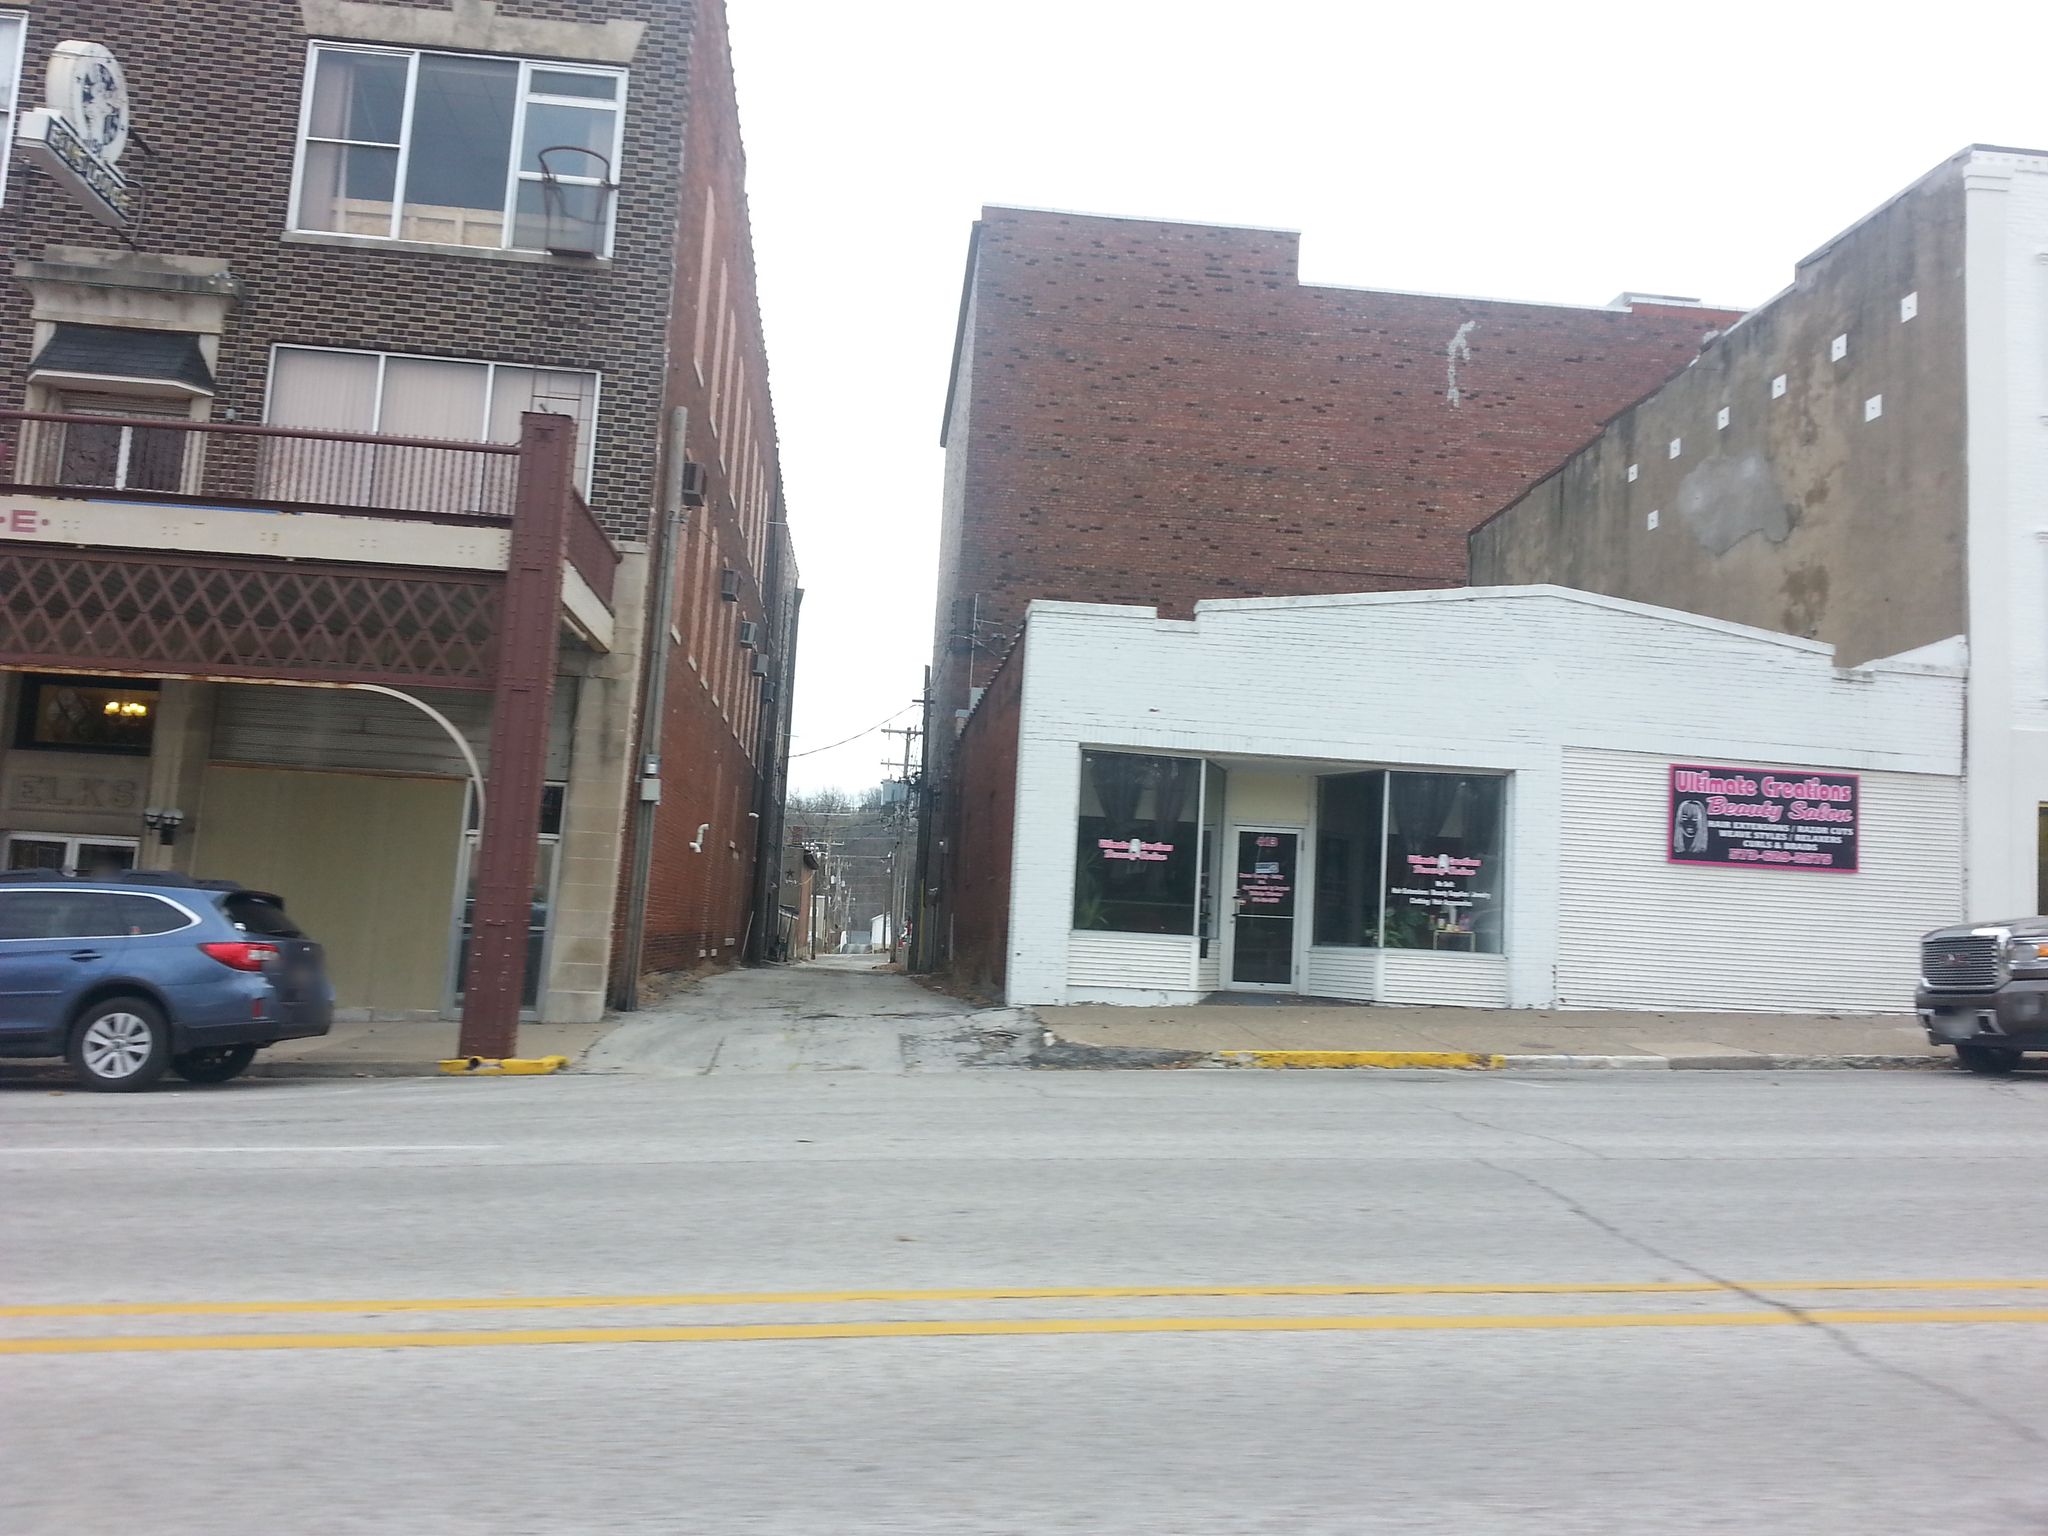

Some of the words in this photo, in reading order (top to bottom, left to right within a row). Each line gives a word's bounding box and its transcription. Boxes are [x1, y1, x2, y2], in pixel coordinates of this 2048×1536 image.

[17, 775, 136, 808] ELKS
[1675, 770, 1758, 796] Ultimate
[1761, 776, 1852, 802] Creations
[1706, 796, 1784, 822] Beauty
[1788, 800, 1853, 822] Salon
[1708, 820, 1732, 829] HAIR
[1733, 821, 1790, 832] EXTENSIONS
[1830, 827, 1854, 836] CUTS
[1718, 830, 1752, 839] WEAVE
[1754, 831, 1788, 841] STYLES
[1794, 834, 1843, 844] RELAXERS
[1743, 840, 1772, 849] CURLS
